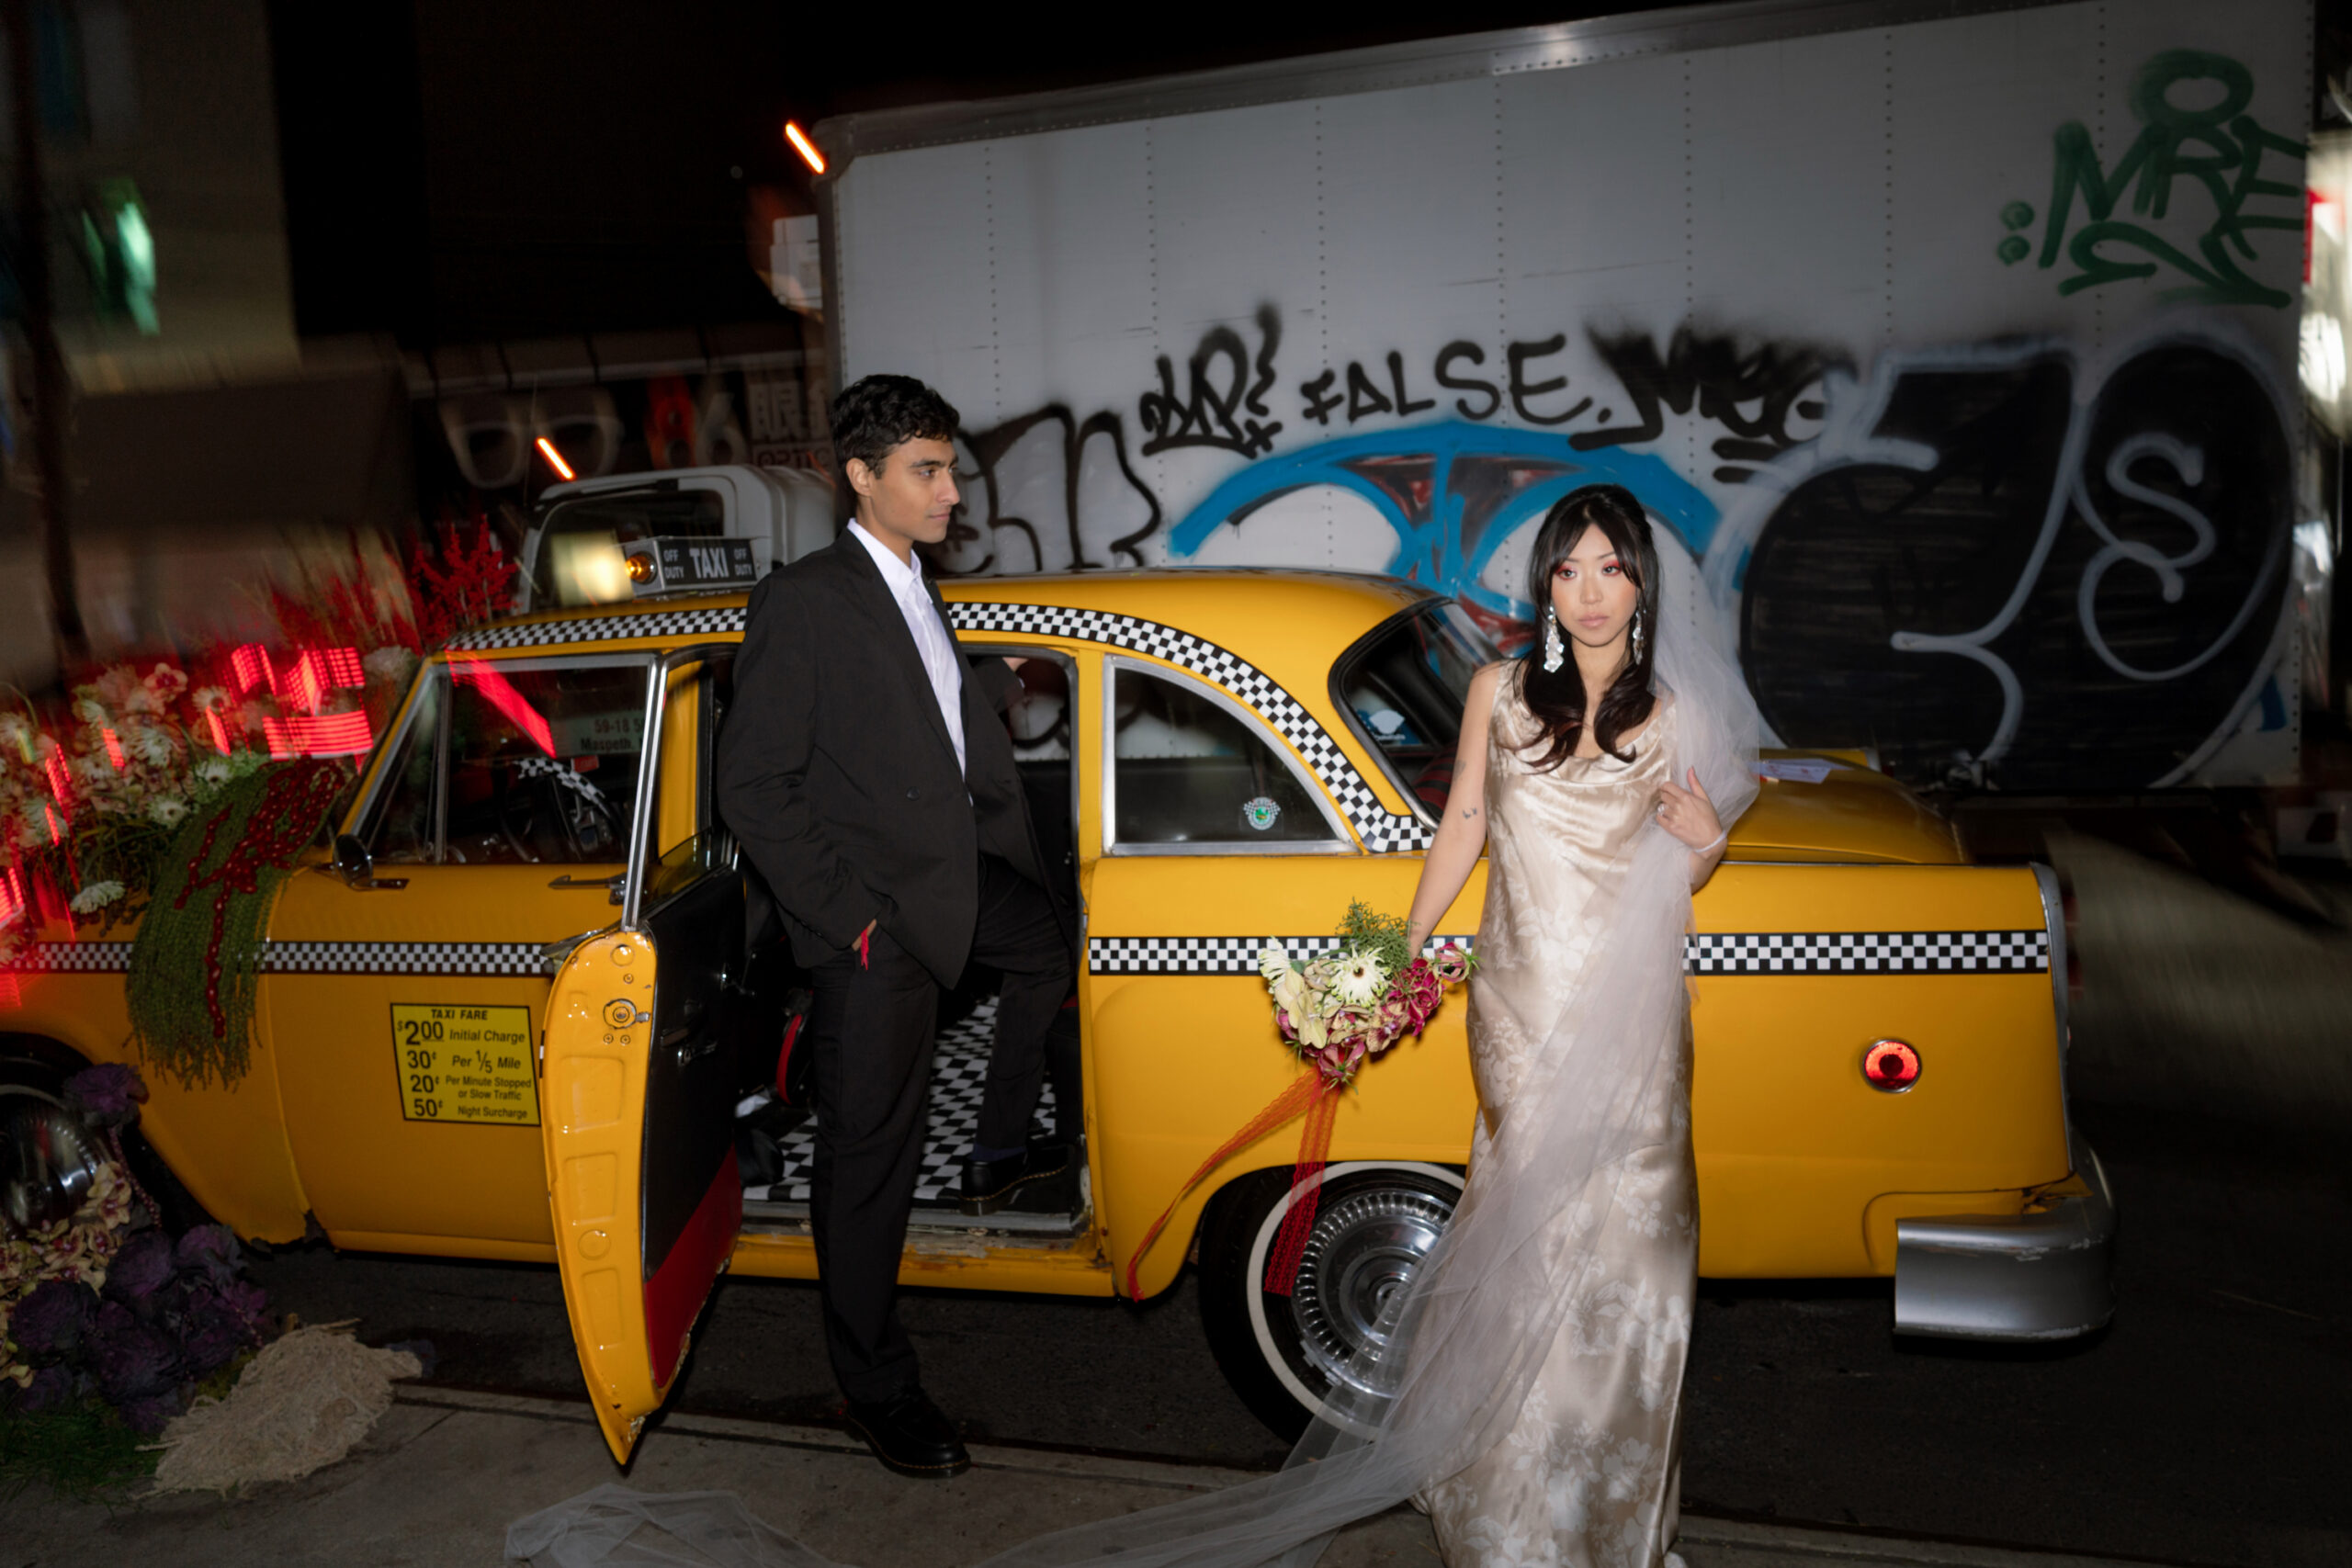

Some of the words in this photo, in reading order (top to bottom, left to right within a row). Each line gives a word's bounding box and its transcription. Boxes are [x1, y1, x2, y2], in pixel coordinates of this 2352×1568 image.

[663, 549, 679, 562] OFF
[734, 548, 747, 560] OFF
[689, 547, 729, 579] TAXI
[664, 566, 684, 579] DUTY
[735, 564, 752, 577] DUTY
[431, 1009, 456, 1020] TAXI
[459, 1010, 489, 1021] FARE
[449, 1029, 481, 1041] Initial
[483, 1030, 526, 1044] Charge
[452, 1055, 472, 1066] Per
[497, 1056, 521, 1069] Mile
[446, 1075, 460, 1086] Per
[462, 1076, 492, 1087] Minute
[494, 1077, 532, 1089] Stopped
[458, 1090, 468, 1099] or
[469, 1089, 492, 1099] Slow
[494, 1089, 522, 1100] Traffic
[458, 1105, 481, 1118] Night
[483, 1106, 527, 1121] Surcharge
